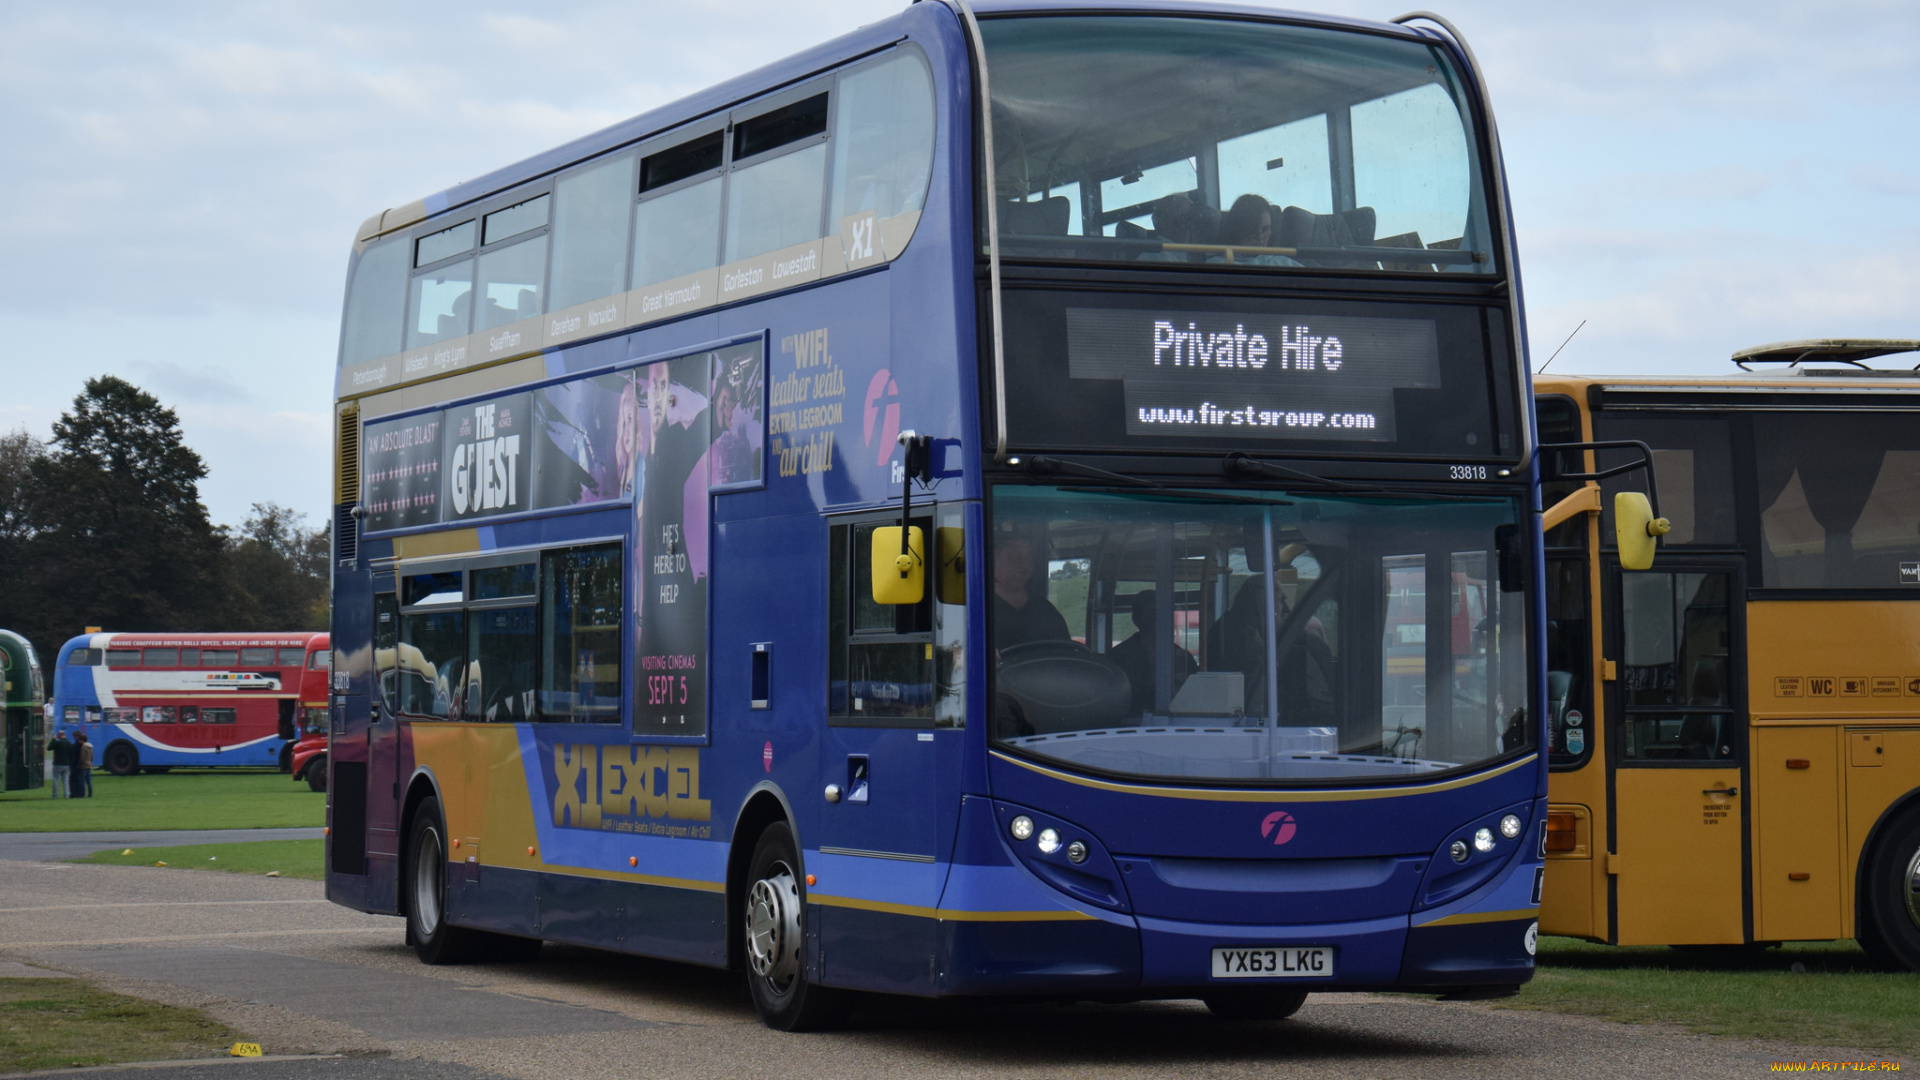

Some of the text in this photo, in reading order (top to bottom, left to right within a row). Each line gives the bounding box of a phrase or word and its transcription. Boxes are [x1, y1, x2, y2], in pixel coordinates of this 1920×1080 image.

[850, 217, 873, 261] X1
[724, 249, 816, 292] Gorleston Lowestoft
[642, 280, 701, 313] Great Yarmouth
[551, 303, 617, 336] Dereham Norwich
[489, 331, 521, 352] Swaffham
[794, 327, 832, 370] WIFI,
[1154, 321, 1343, 371] Private Hire
[770, 364, 846, 407] leather seats,
[475, 403, 496, 440] THE
[769, 402, 843, 435] EXTRA LEGROOM
[1138, 402, 1376, 429] www.firstgroup.com
[380, 428, 413, 452] ABSOLUTE
[780, 436, 801, 478] air
[801, 430, 834, 474] chill
[451, 434, 520, 514] GUEST
[1450, 465, 1487, 479] 33818
[662, 524, 679, 544] HE'S
[654, 553, 686, 574] HERE TO
[660, 584, 679, 604] HELP
[642, 654, 696, 670] VISITING CINEMAS
[648, 675, 688, 705] SEPT 5
[1811, 679, 1832, 695] WC
[554, 743, 711, 828] X1 EXCEL
[616, 820, 633, 832] Leather
[634, 822, 648, 834] Seats
[652, 823, 665, 835] Extra
[1221, 950, 1324, 973] YX63 LKG
